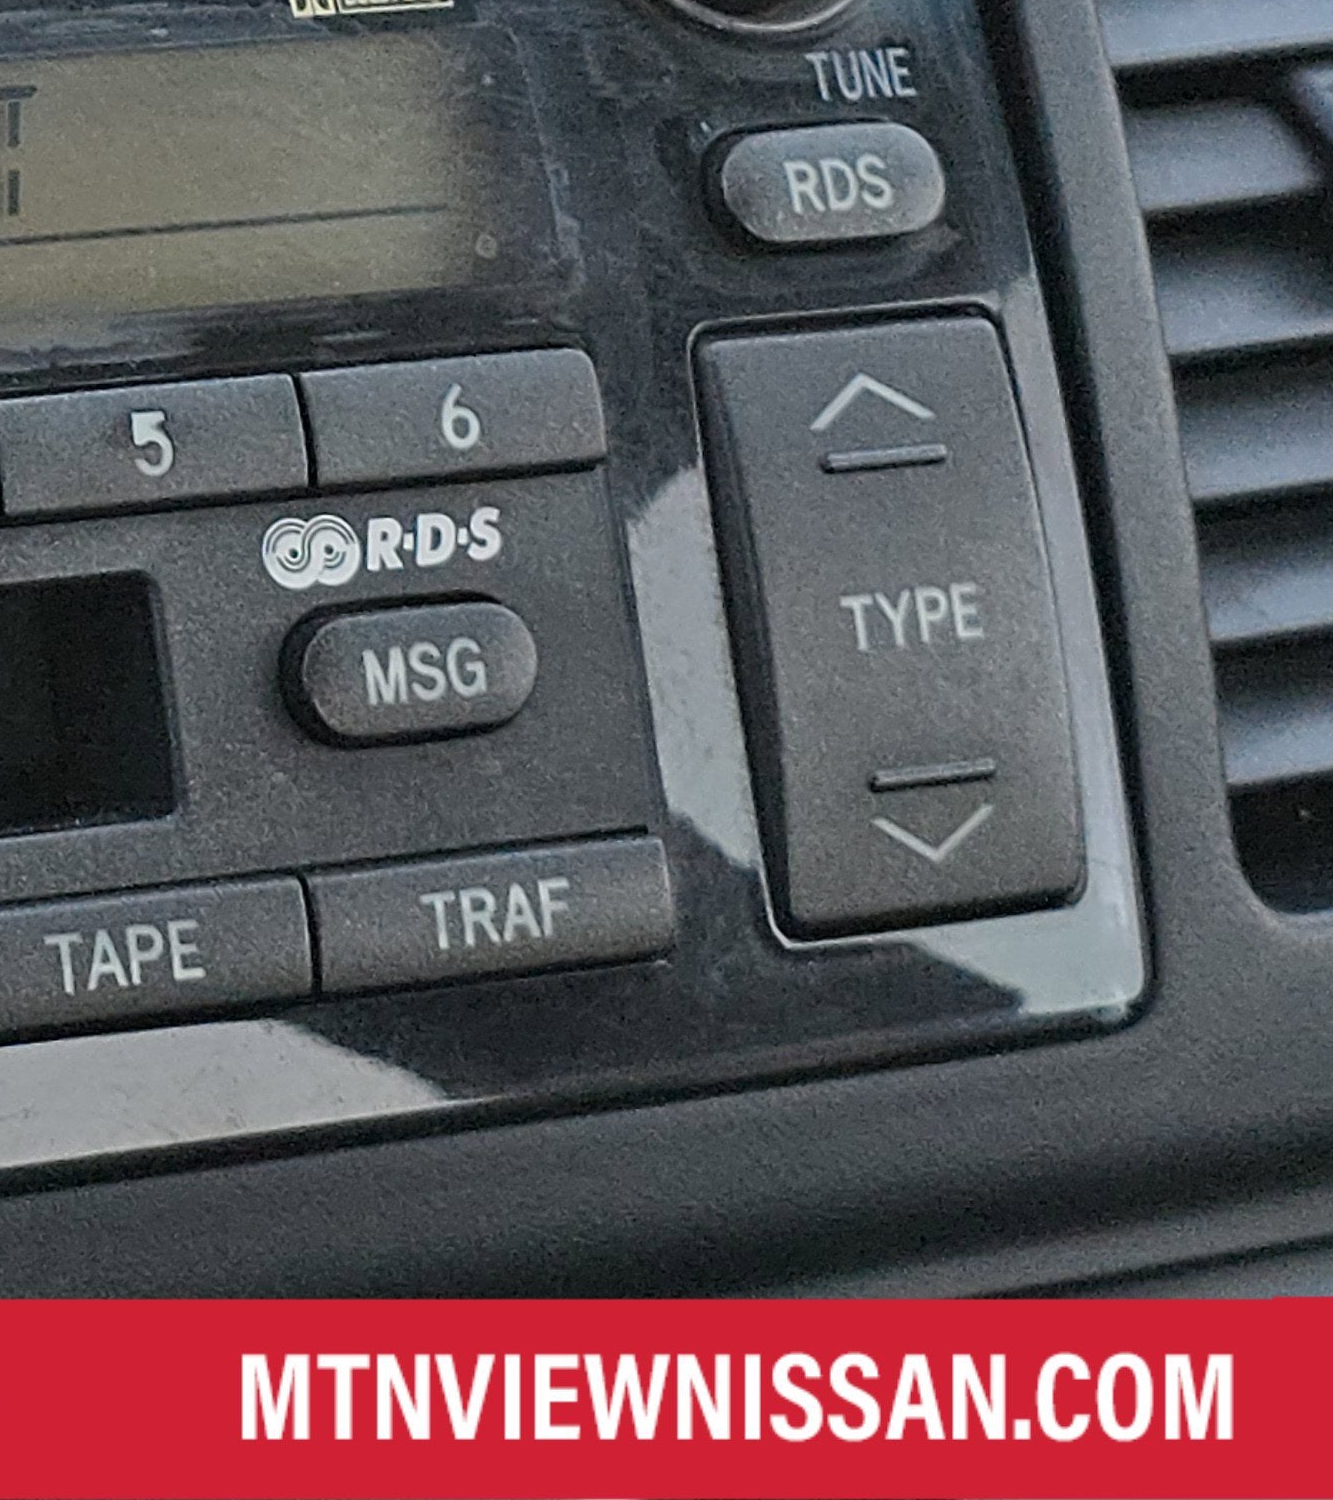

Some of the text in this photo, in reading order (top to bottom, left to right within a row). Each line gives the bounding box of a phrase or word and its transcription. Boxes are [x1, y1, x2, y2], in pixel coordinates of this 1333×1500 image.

[804, 47, 917, 102] TUNE
[783, 157, 894, 212] RDS
[132, 409, 174, 477] 5
[441, 383, 480, 451] 6
[839, 582, 984, 650] TYPE
[362, 637, 487, 704] MSG
[419, 877, 569, 949] TRAF
[44, 920, 206, 995] TAPE
